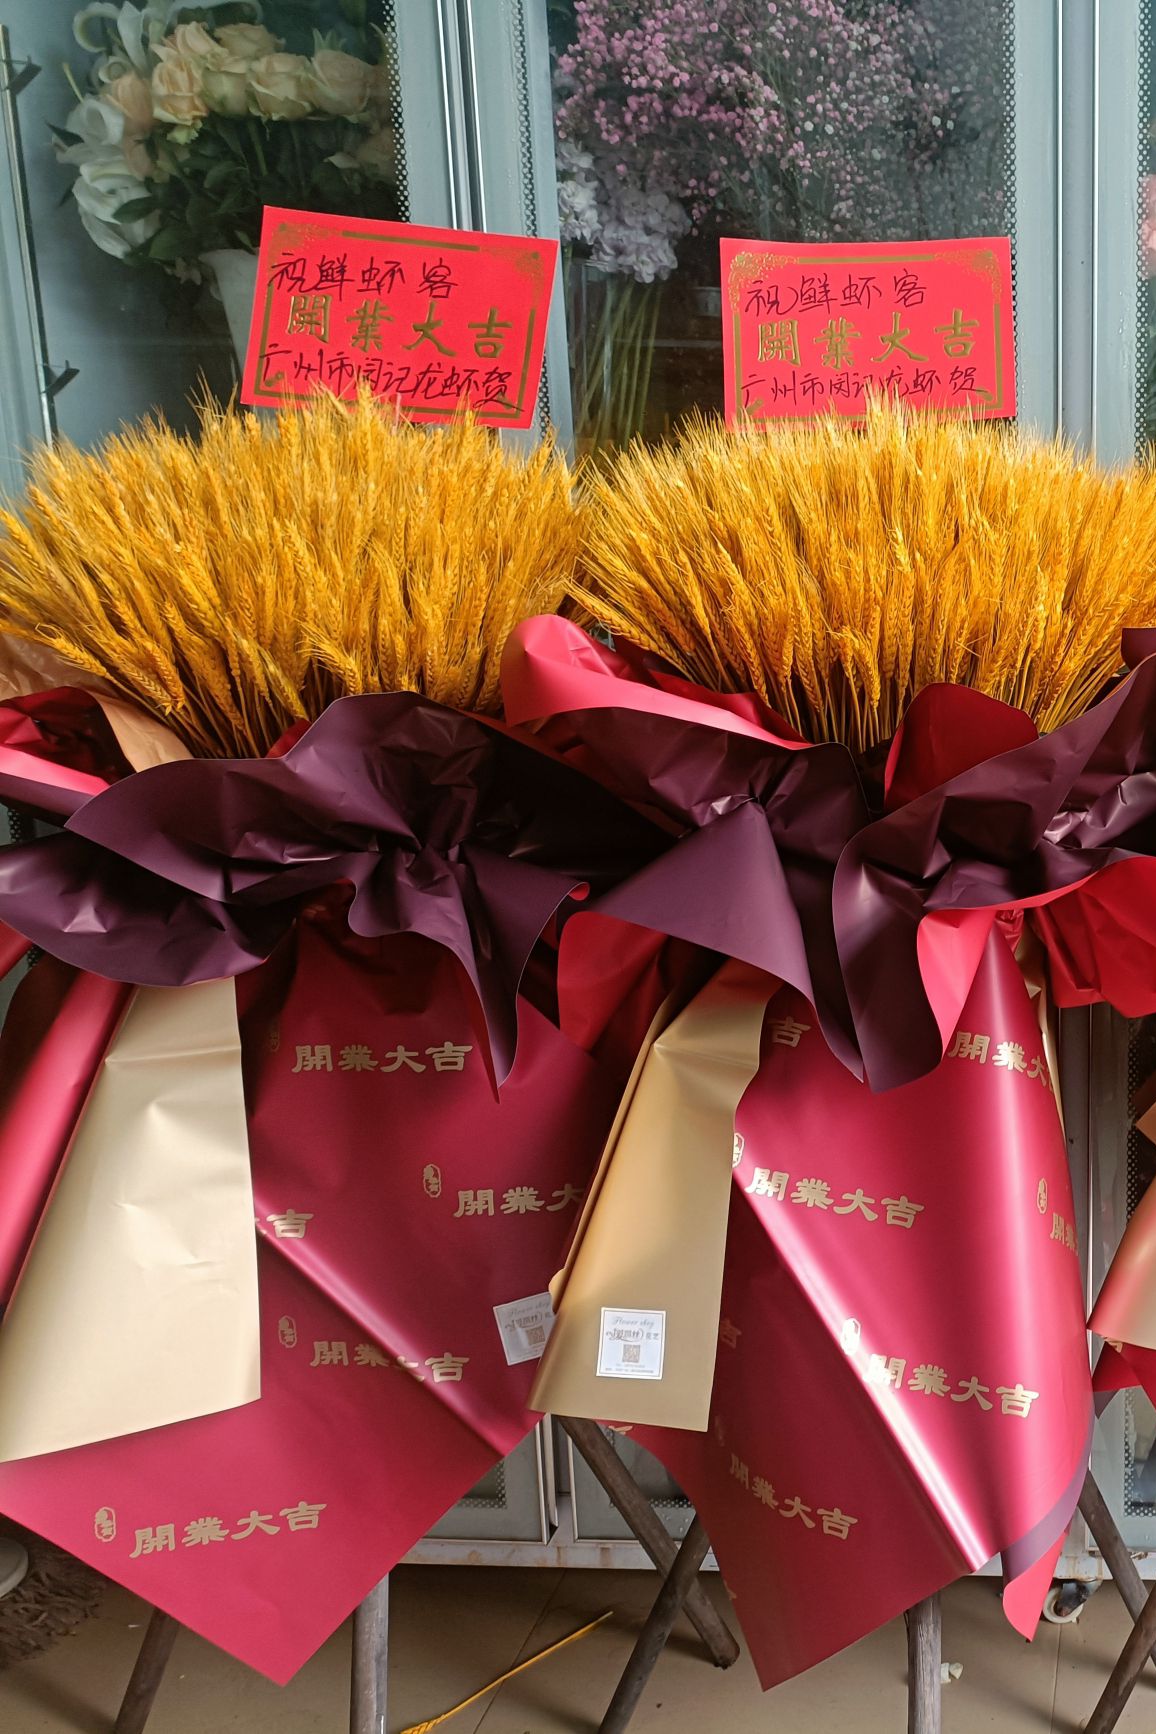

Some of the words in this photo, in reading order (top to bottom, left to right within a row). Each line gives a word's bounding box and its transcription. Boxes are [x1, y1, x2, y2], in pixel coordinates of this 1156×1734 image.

[744, 269, 927, 317] 祝鲜虾客
[286, 294, 513, 359] 開業大吉
[757, 308, 979, 370] 開業大吉
[292, 1041, 472, 1073] 開業大吉
[947, 1031, 1054, 1092] 開業大
[255, 1209, 314, 1238] 吉
[744, 1166, 925, 1229] 開業大吉
[864, 1353, 1039, 1419] 開業大吉
[729, 1453, 859, 1541] 開業大吉
[129, 1501, 327, 1559] 開業大吉
